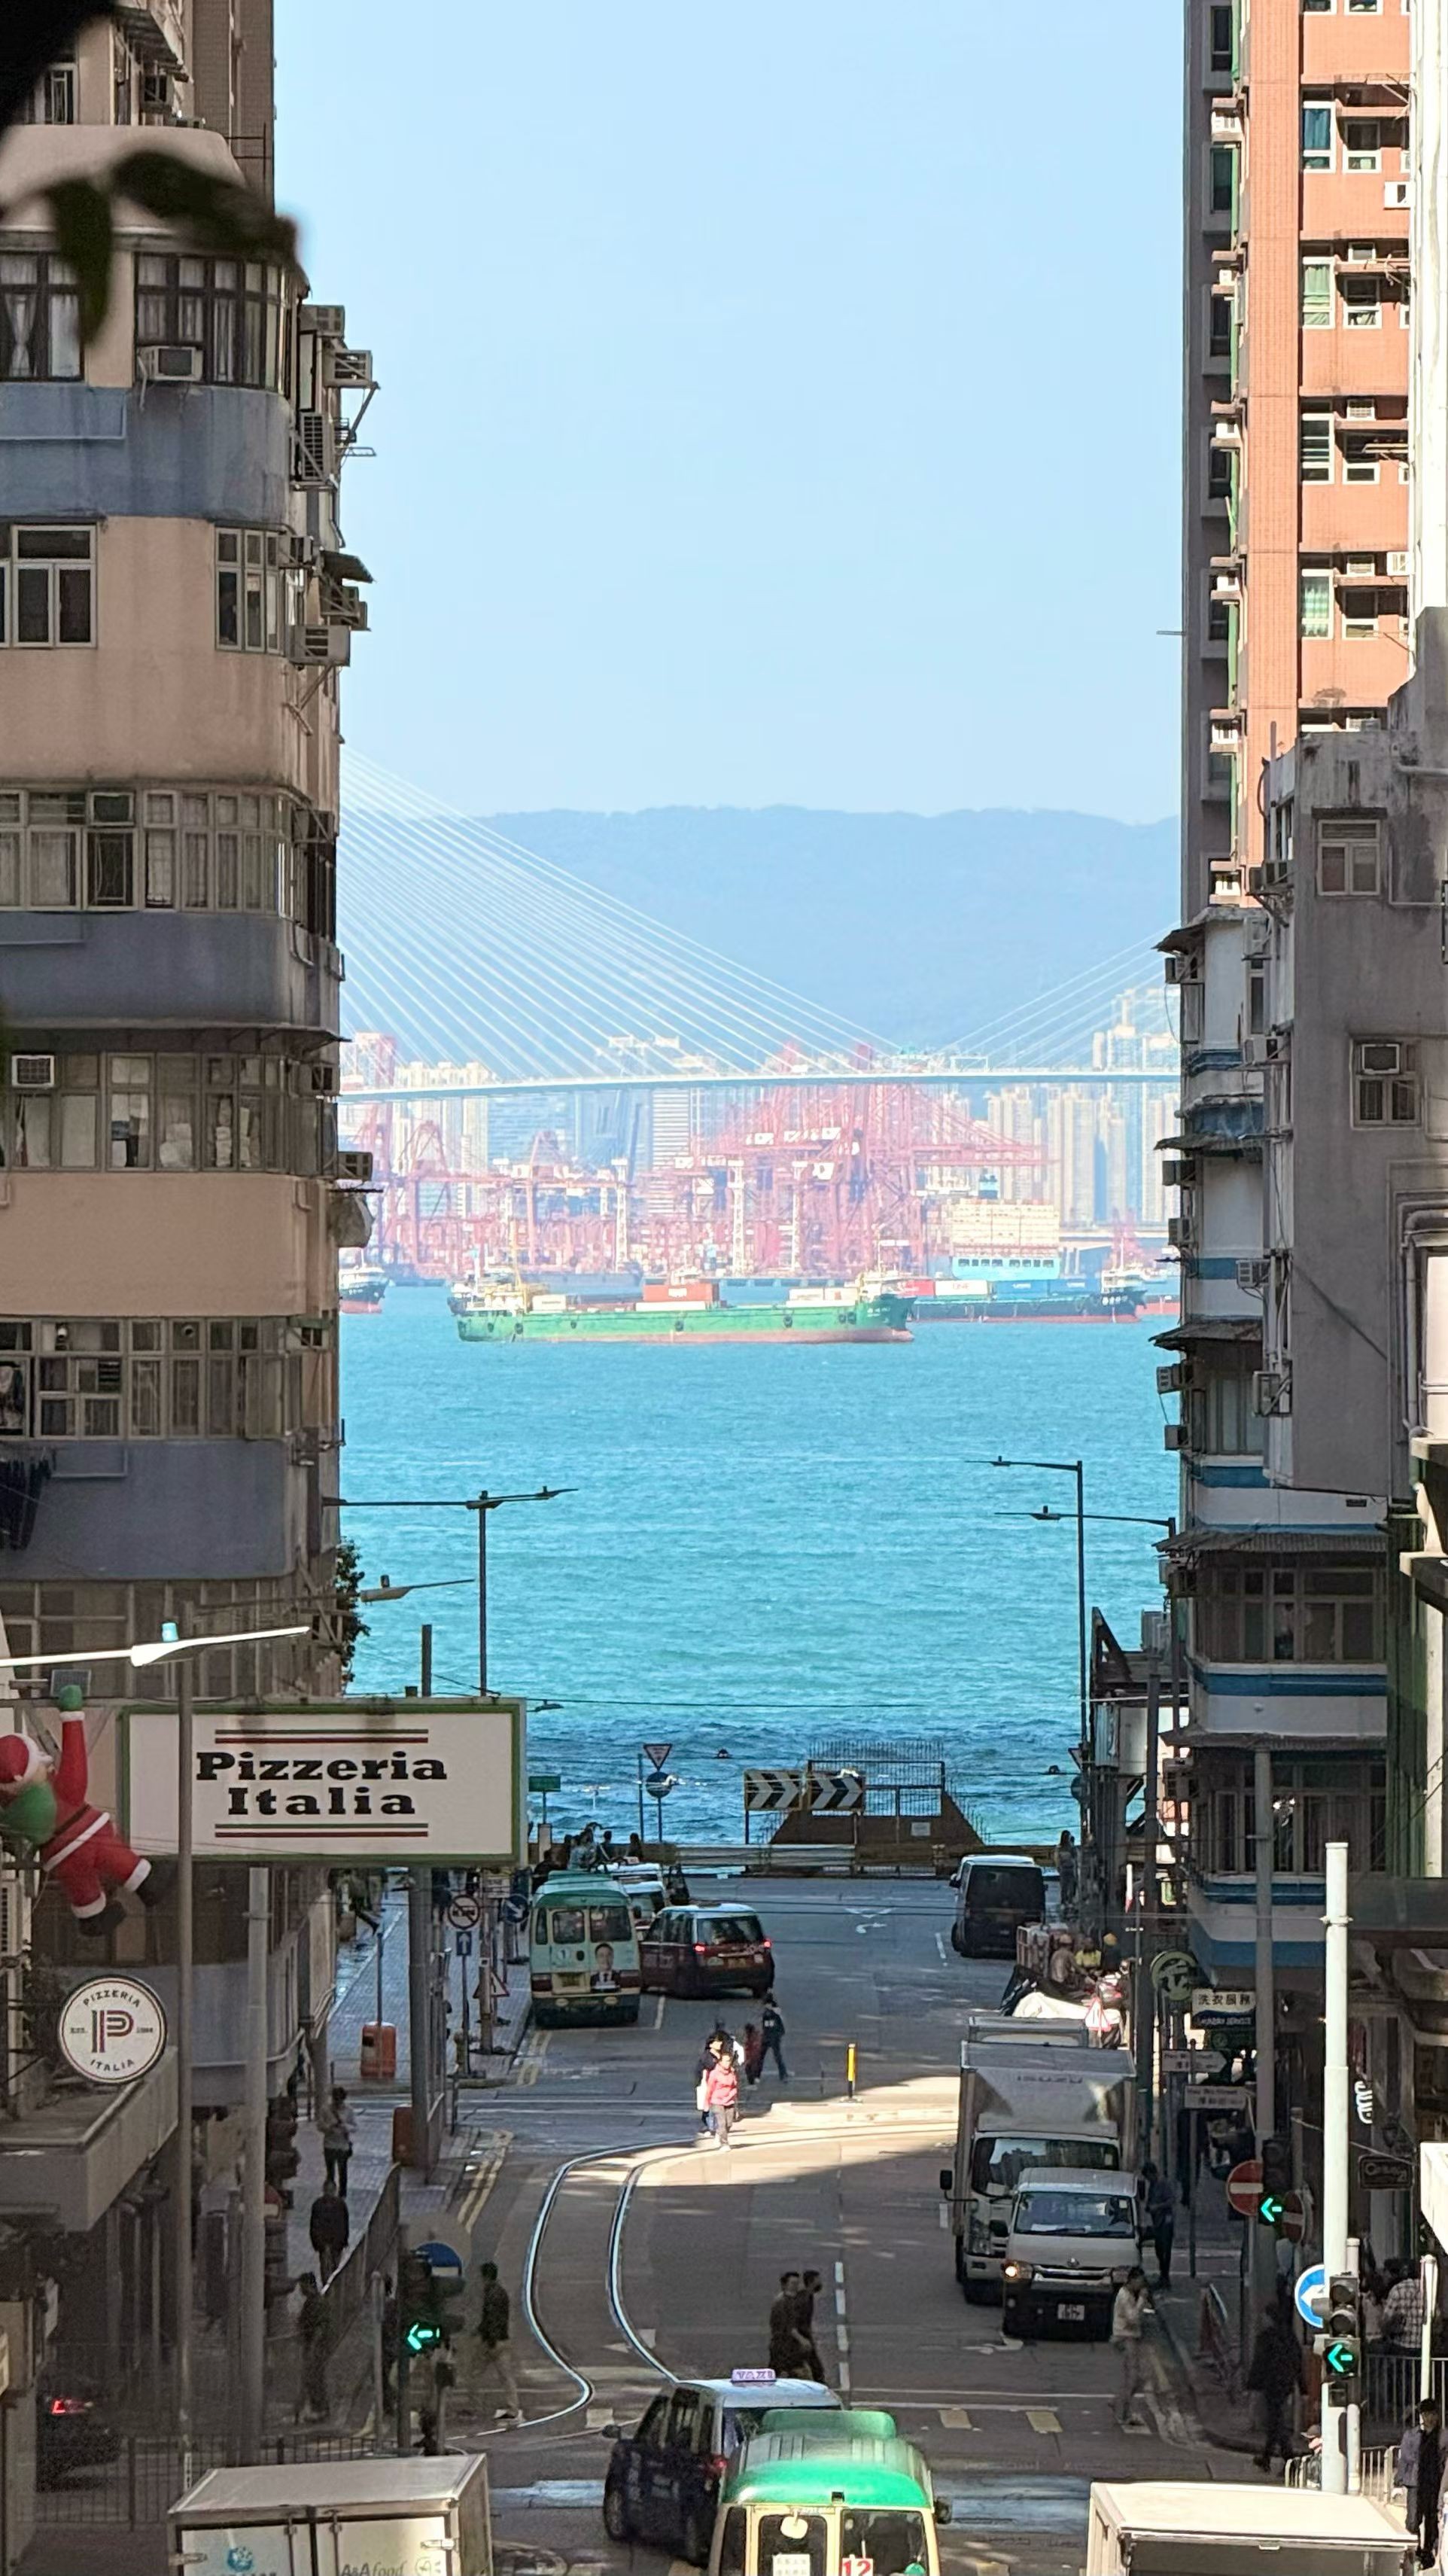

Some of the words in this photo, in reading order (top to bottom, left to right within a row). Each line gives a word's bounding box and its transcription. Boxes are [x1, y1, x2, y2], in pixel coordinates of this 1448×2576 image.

[196, 1751, 448, 1780] Pizzeria
[228, 1786, 415, 1816] Italia
[83, 1990, 140, 2008] PIZZERIA
[90, 2059, 135, 2072] ITALIA
[843, 2560, 872, 2576] 12
